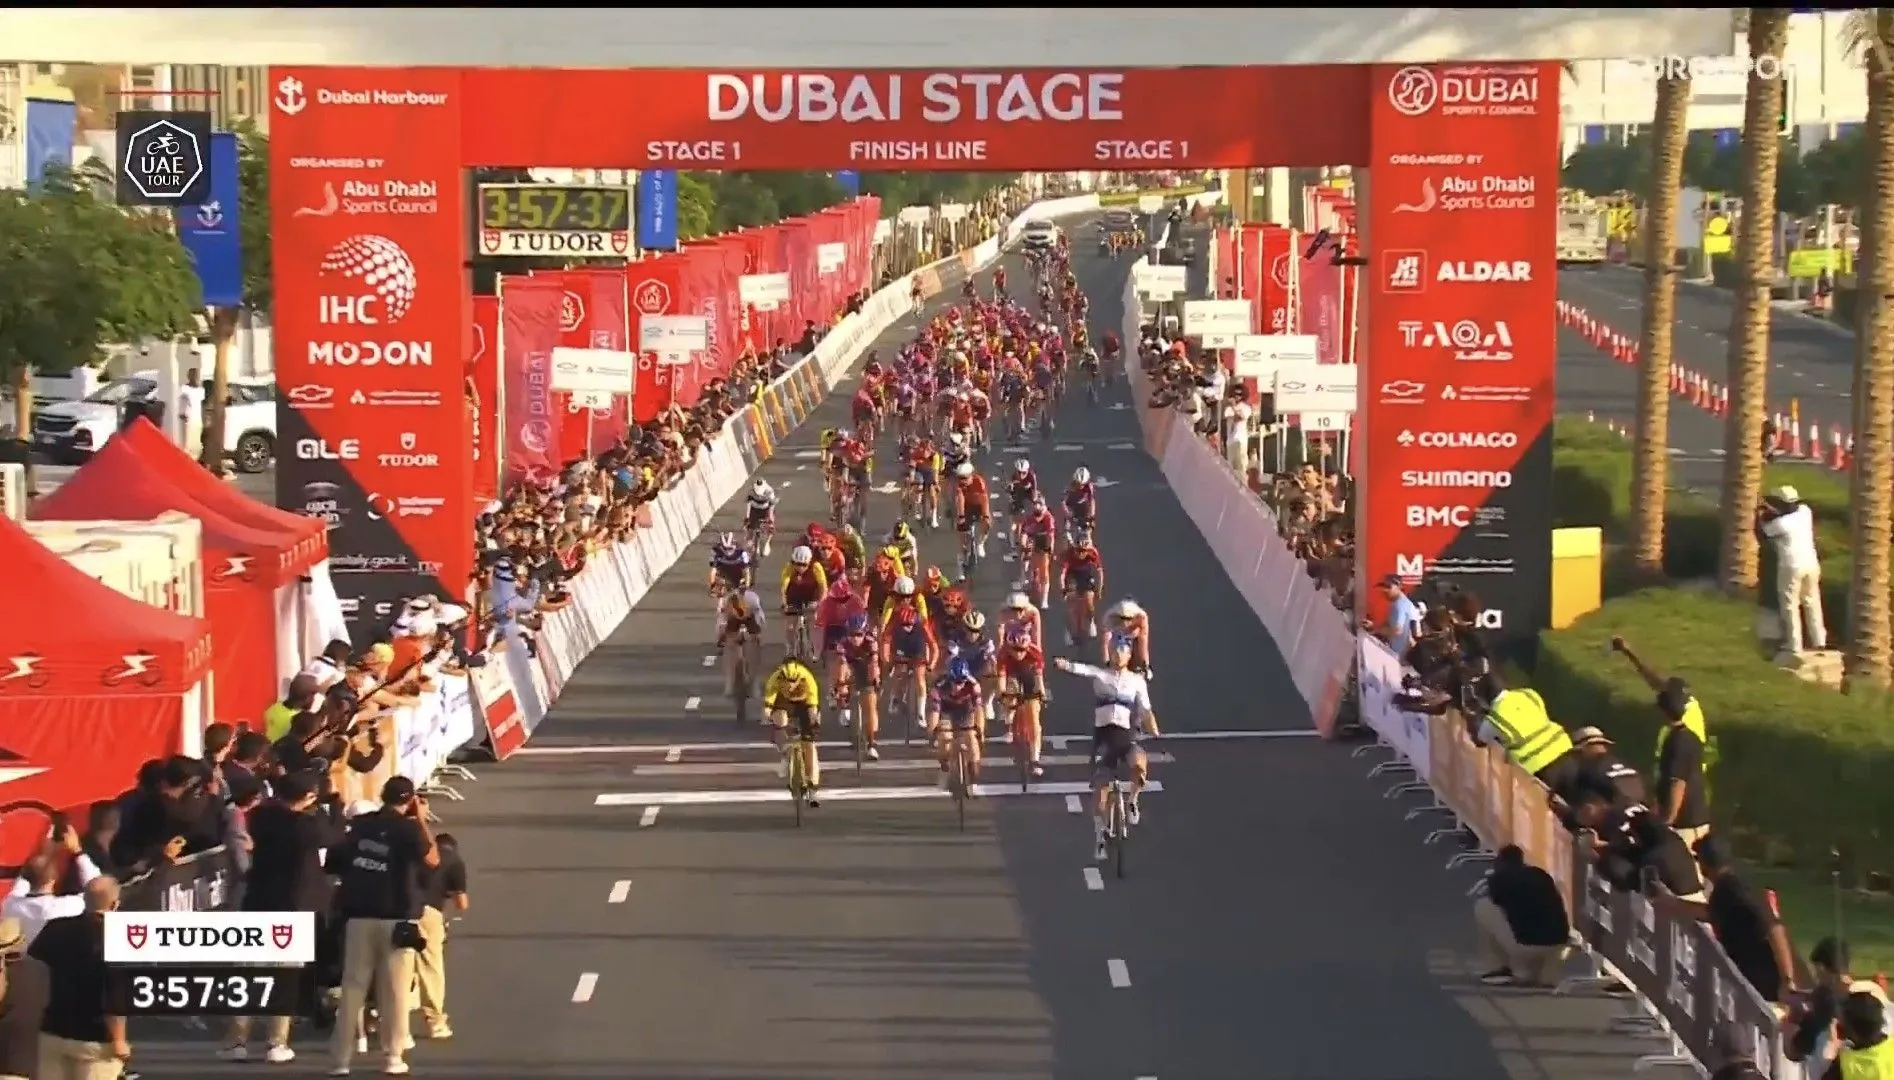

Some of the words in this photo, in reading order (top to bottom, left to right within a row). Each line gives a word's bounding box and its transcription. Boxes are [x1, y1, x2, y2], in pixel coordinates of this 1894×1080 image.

[316, 88, 371, 105] Dubai
[373, 88, 448, 105] Harbour
[707, 74, 901, 122] DUBAI
[922, 73, 1124, 122] STAGE
[1441, 78, 1538, 102] DUBAI
[647, 141, 726, 160] STAGE
[732, 141, 741, 160] 1
[850, 141, 928, 160] FINISH
[934, 141, 987, 160] LINE
[1094, 140, 1174, 160] STAGE
[1180, 140, 1189, 159] 1
[366, 157, 385, 168] BY
[1466, 154, 1484, 165] BY
[342, 180, 380, 197] Abu
[384, 180, 437, 197] Dhabi
[1441, 176, 1477, 193] Abu
[1482, 176, 1535, 193] Dhabi
[342, 198, 387, 215] Sports
[389, 198, 437, 213] Council
[484, 188, 626, 229] 3:57:37
[1440, 195, 1484, 211] Sports
[1486, 195, 1535, 209] Council
[508, 233, 605, 252] TUDOR
[1436, 260, 1533, 282] ALDAR
[319, 294, 379, 325] IHC
[1397, 320, 1513, 348] TAQA
[1317, 417, 1331, 427] 10
[1418, 431, 1518, 448] COLNAGO
[377, 453, 440, 467] TUDOR
[1401, 470, 1512, 488] SHIMANO
[1406, 505, 1471, 528] BMC
